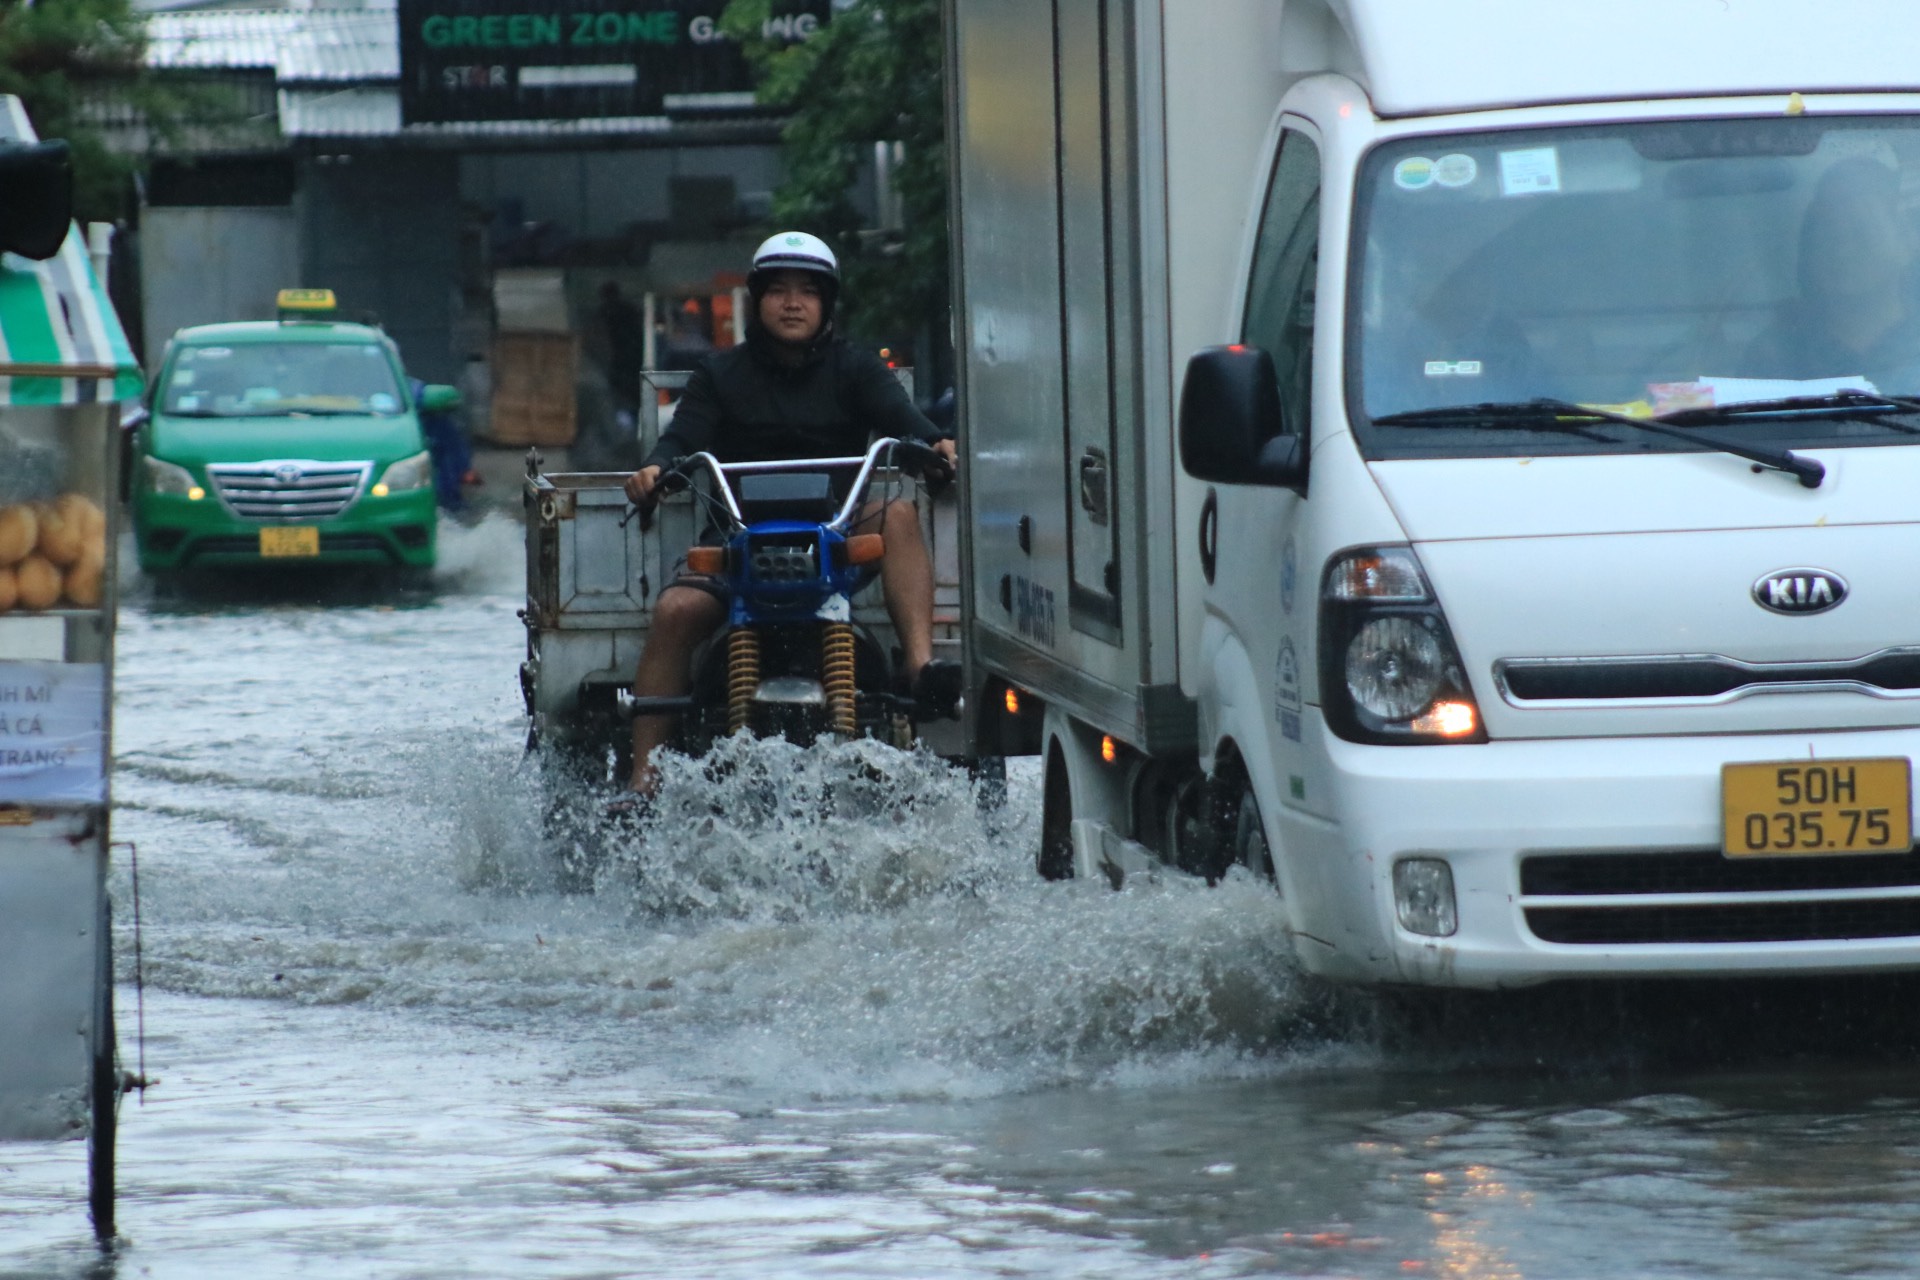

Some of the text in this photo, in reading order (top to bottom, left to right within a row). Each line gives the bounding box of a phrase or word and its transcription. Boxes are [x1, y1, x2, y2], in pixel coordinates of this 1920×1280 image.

[421, 14, 560, 47] GREEN
[570, 11, 679, 43] ZONE
[1768, 577, 1834, 605] KIA
[1777, 766, 1856, 806] 50H
[1744, 809, 1890, 851] 035.75
